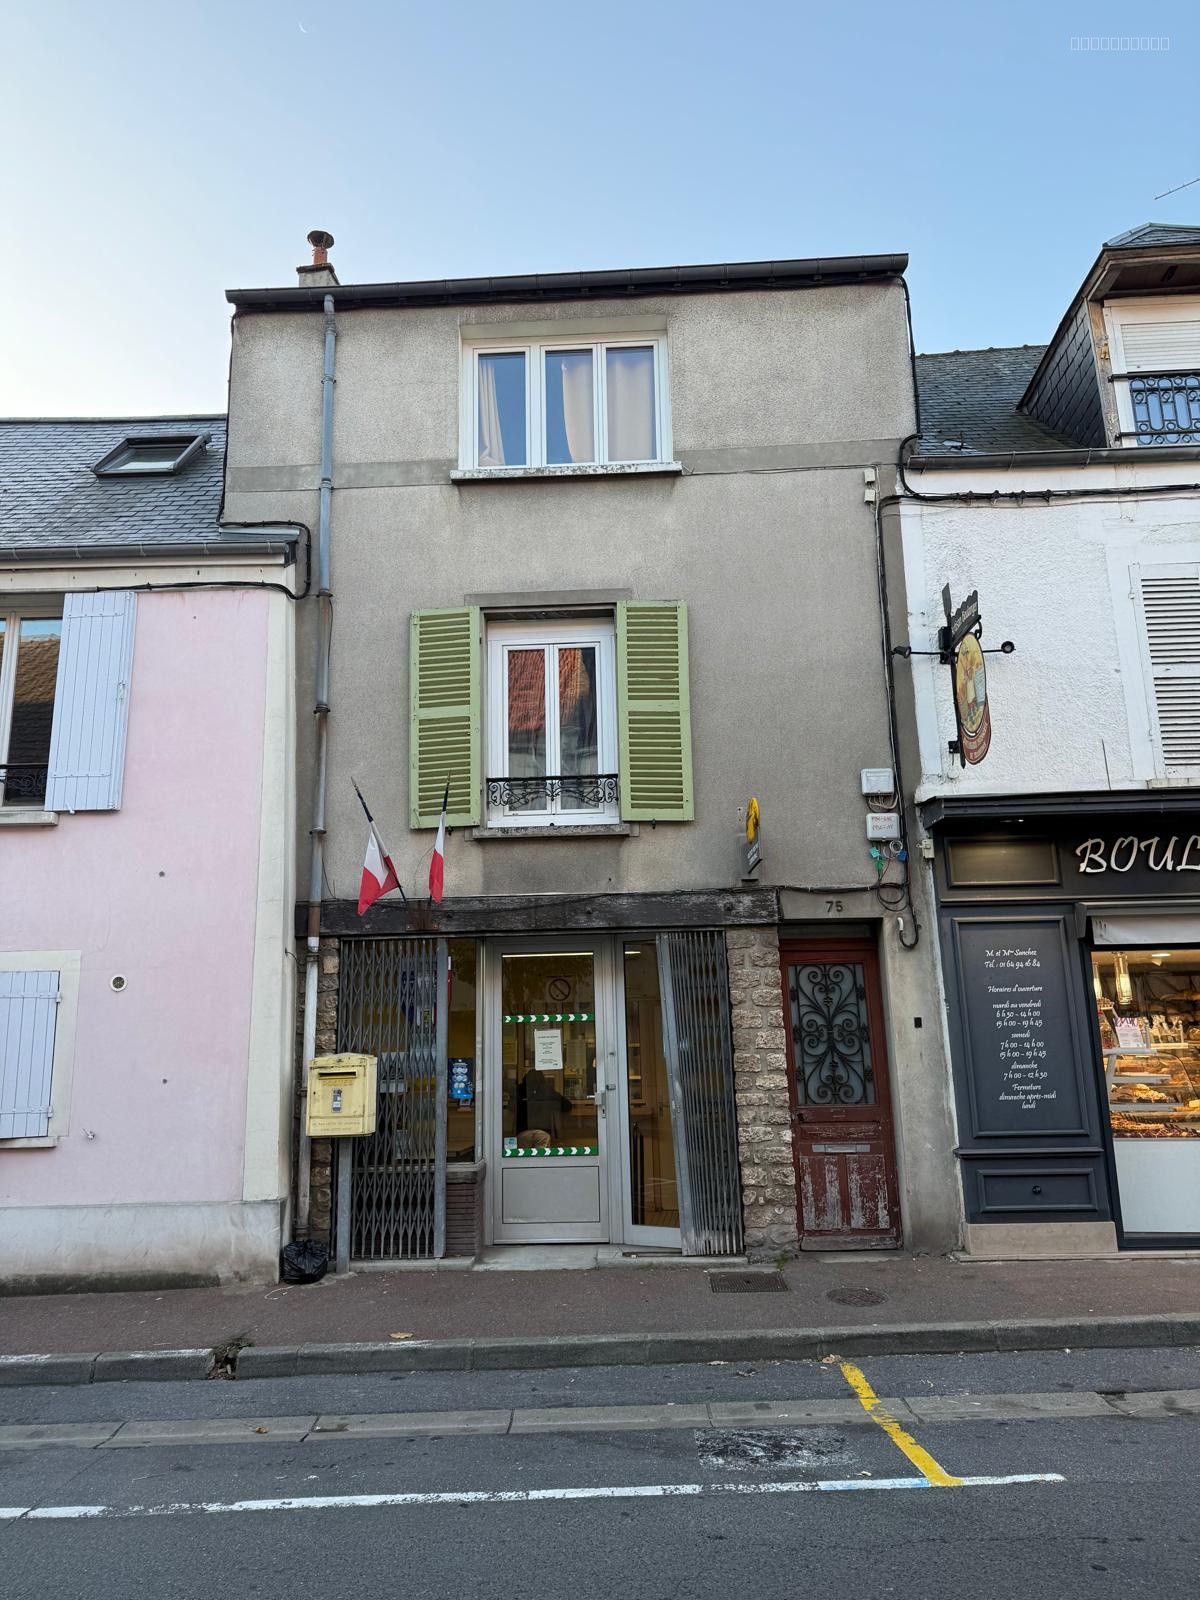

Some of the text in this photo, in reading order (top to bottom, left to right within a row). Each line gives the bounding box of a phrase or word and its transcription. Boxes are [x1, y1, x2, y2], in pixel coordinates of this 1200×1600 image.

[1075, 835, 1200, 873] BOUL
[825, 900, 843, 913] 75
[1014, 948, 1037, 956] Sanchez
[1006, 960, 1014, 968] 64
[1015, 961, 1024, 970] 94
[1032, 959, 1040, 967] 84
[987, 984, 1042, 993] Horaires d'ouverture
[992, 1000, 1009, 1009] mardi
[1018, 999, 1041, 1008] vendredi
[996, 1010, 1000, 1018] 6
[1006, 1011, 1014, 1019] 30
[996, 1020, 1003, 1028] 15
[1022, 1020, 1029, 1028] 19
[1034, 1019, 1043, 1027] 45
[1011, 1030, 1031, 1038] samedi
[1000, 1042, 1005, 1050] 7
[999, 1051, 1006, 1060] 15
[1025, 1051, 1032, 1059] 19
[1038, 1050, 1047, 1059] 45
[1011, 1060, 1038, 1070] dimanche
[1039, 1071, 1048, 1080] 30
[1012, 1083, 1041, 1091] Fermeture
[999, 1090, 1057, 1103] dimanche après-midi
[1022, 1101, 1036, 1109] lundi
